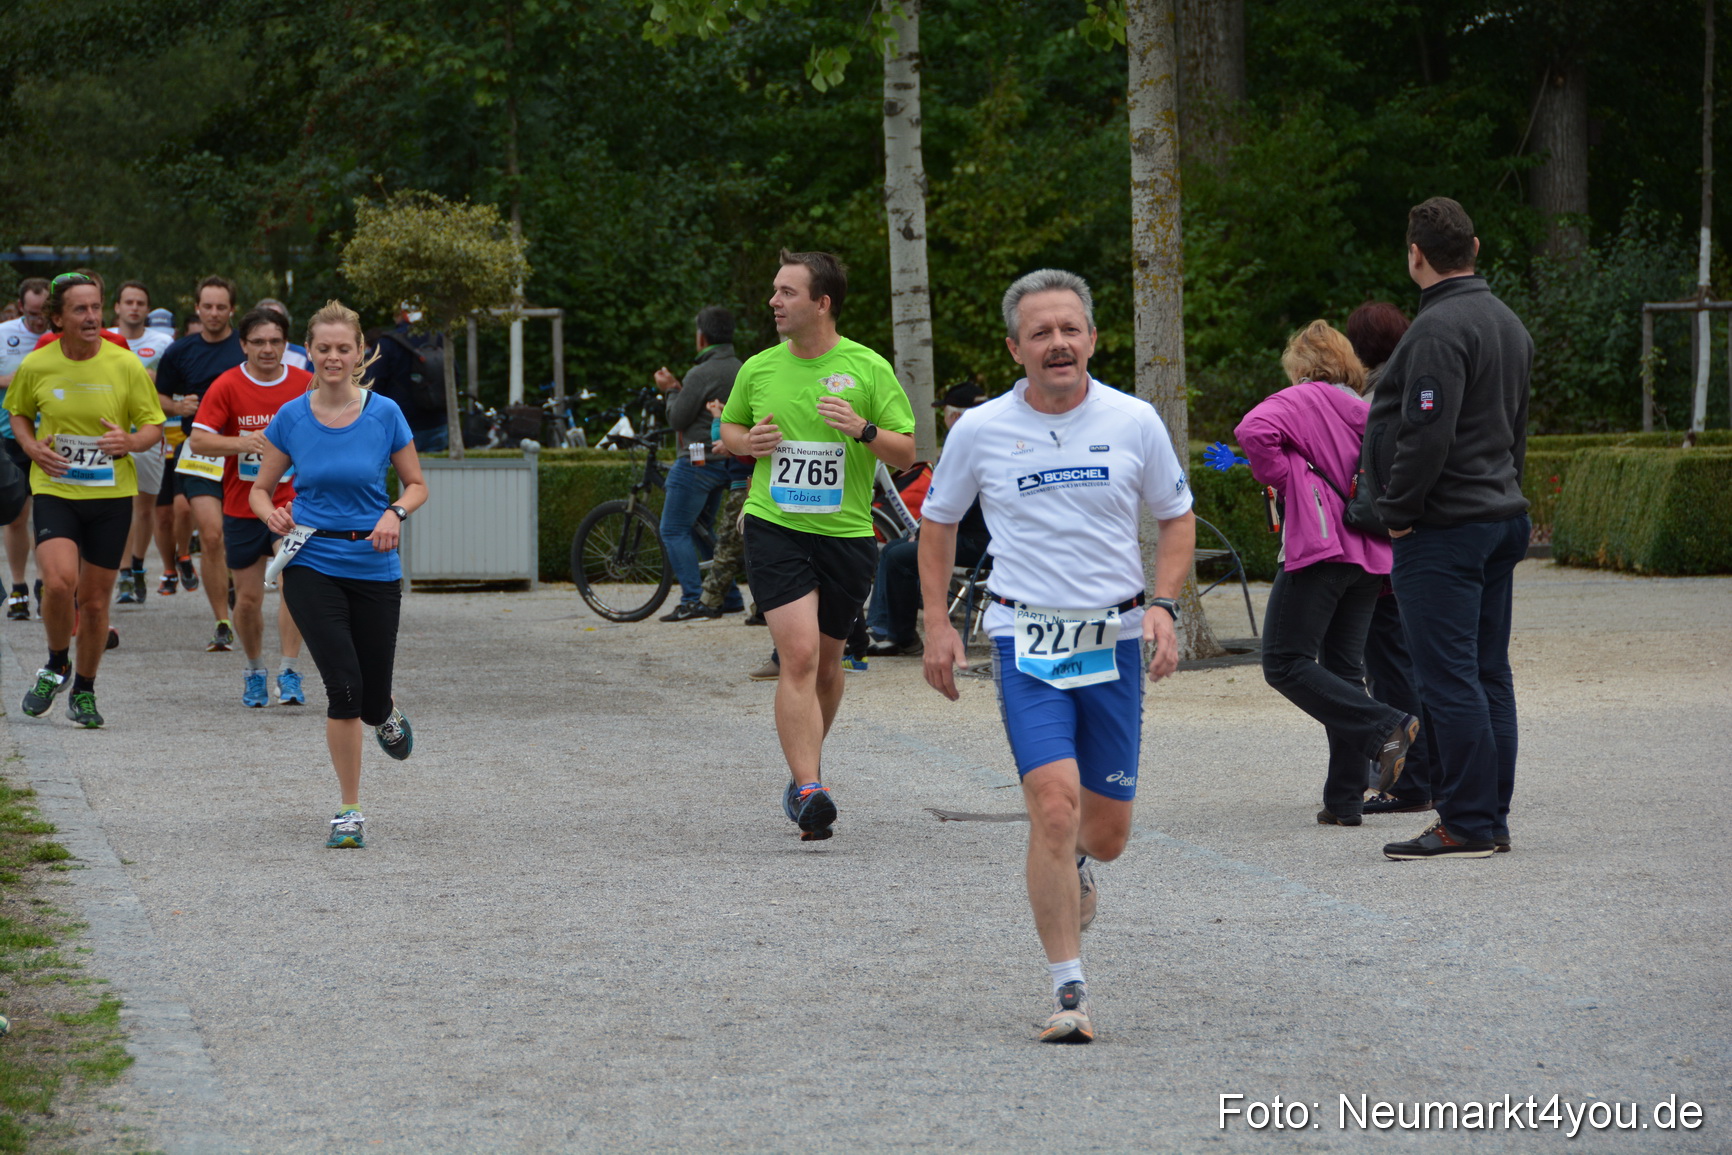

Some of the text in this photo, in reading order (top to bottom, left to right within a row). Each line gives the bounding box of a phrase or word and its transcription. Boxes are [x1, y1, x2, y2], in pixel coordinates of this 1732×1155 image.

[797, 448, 833, 457] Neumarkt
[72, 469, 95, 479] Claus
[777, 457, 838, 486] 2765
[1043, 468, 1106, 483] BÜSCHEL
[787, 489, 822, 503] Tobias
[887, 488, 917, 529] KETTLER
[1017, 609, 1049, 624] PARTL
[1027, 620, 1106, 655] 2277
